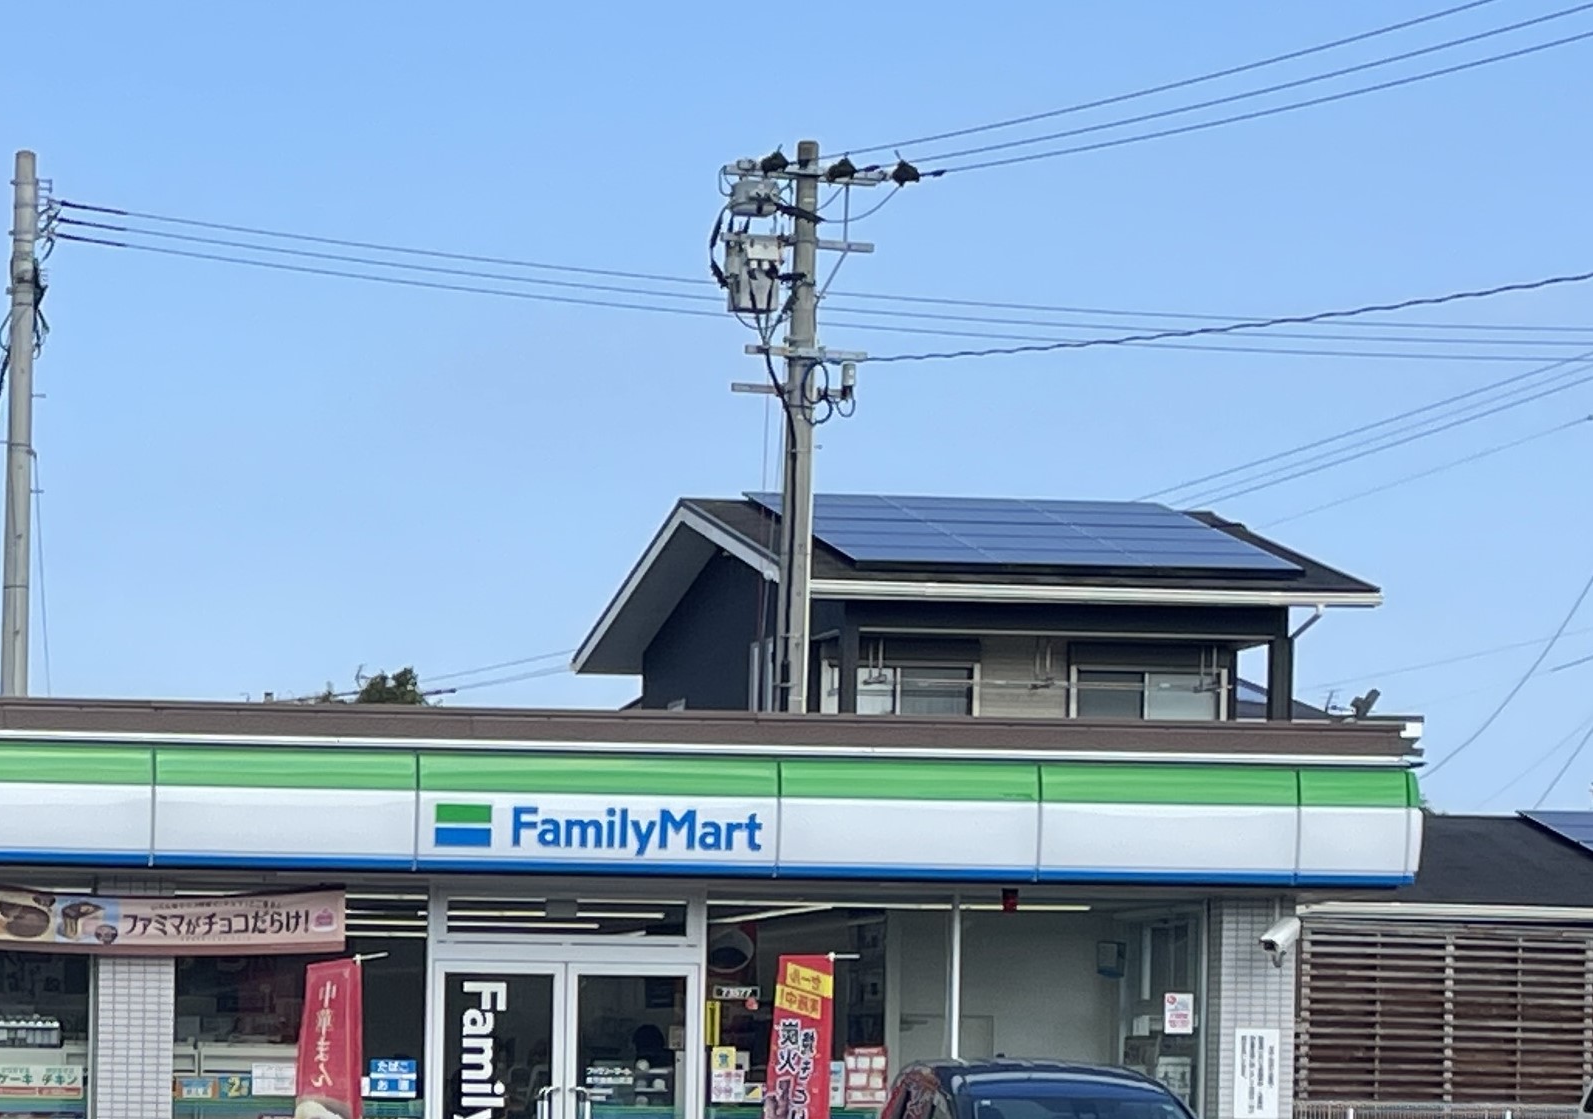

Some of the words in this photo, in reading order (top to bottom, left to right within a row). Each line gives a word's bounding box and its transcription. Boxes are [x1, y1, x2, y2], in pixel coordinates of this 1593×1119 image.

[511, 806, 763, 856] FamilyMart
[377, 1060, 409, 1072] たばこ
